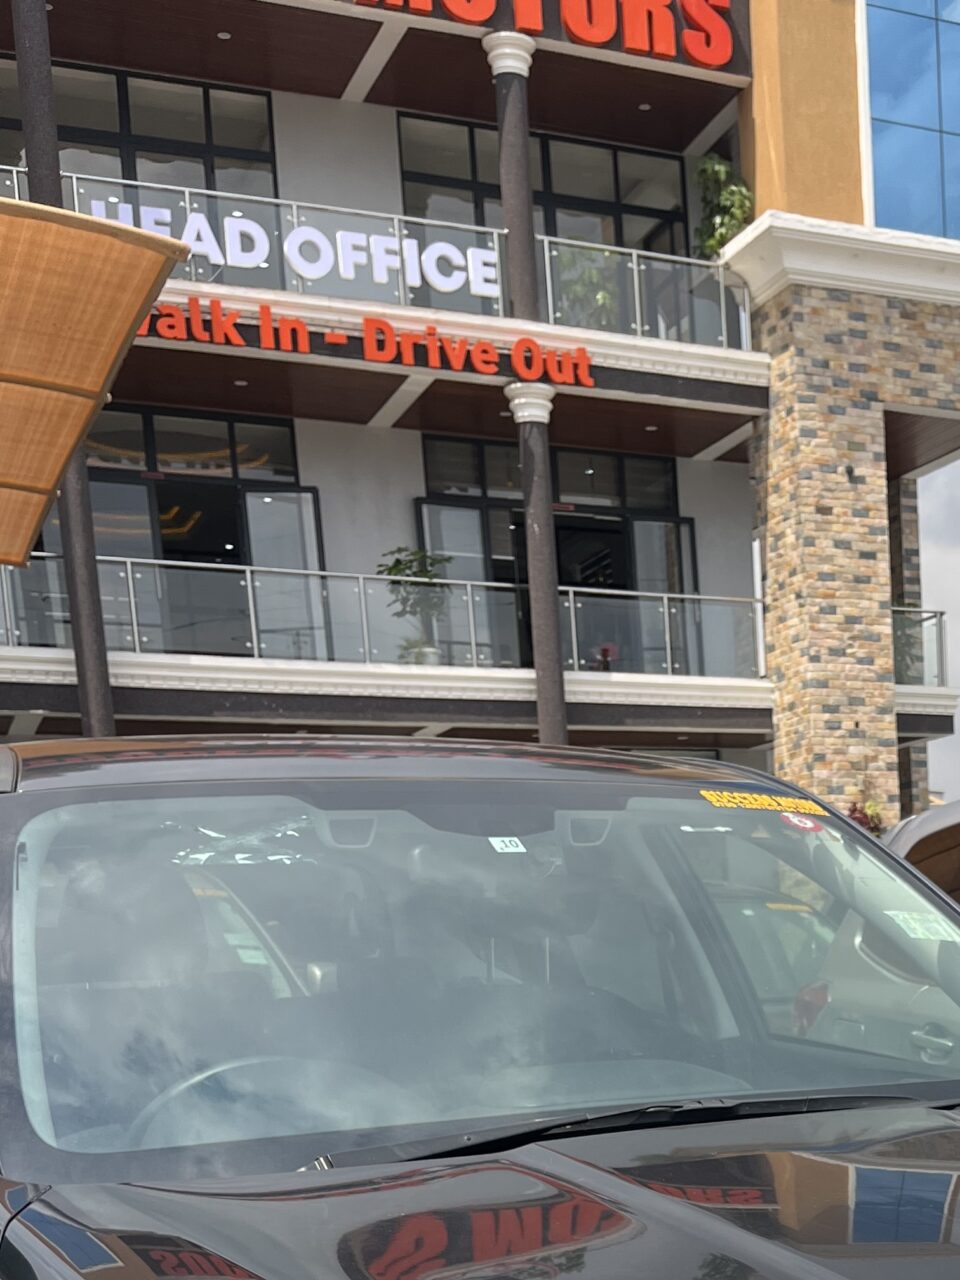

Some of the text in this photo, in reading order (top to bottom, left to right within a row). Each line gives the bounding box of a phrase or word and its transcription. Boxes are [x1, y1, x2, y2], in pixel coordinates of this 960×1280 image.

[283, 226, 499, 299] OFFICE
[137, 297, 596, 388] alk In - Drive Out
